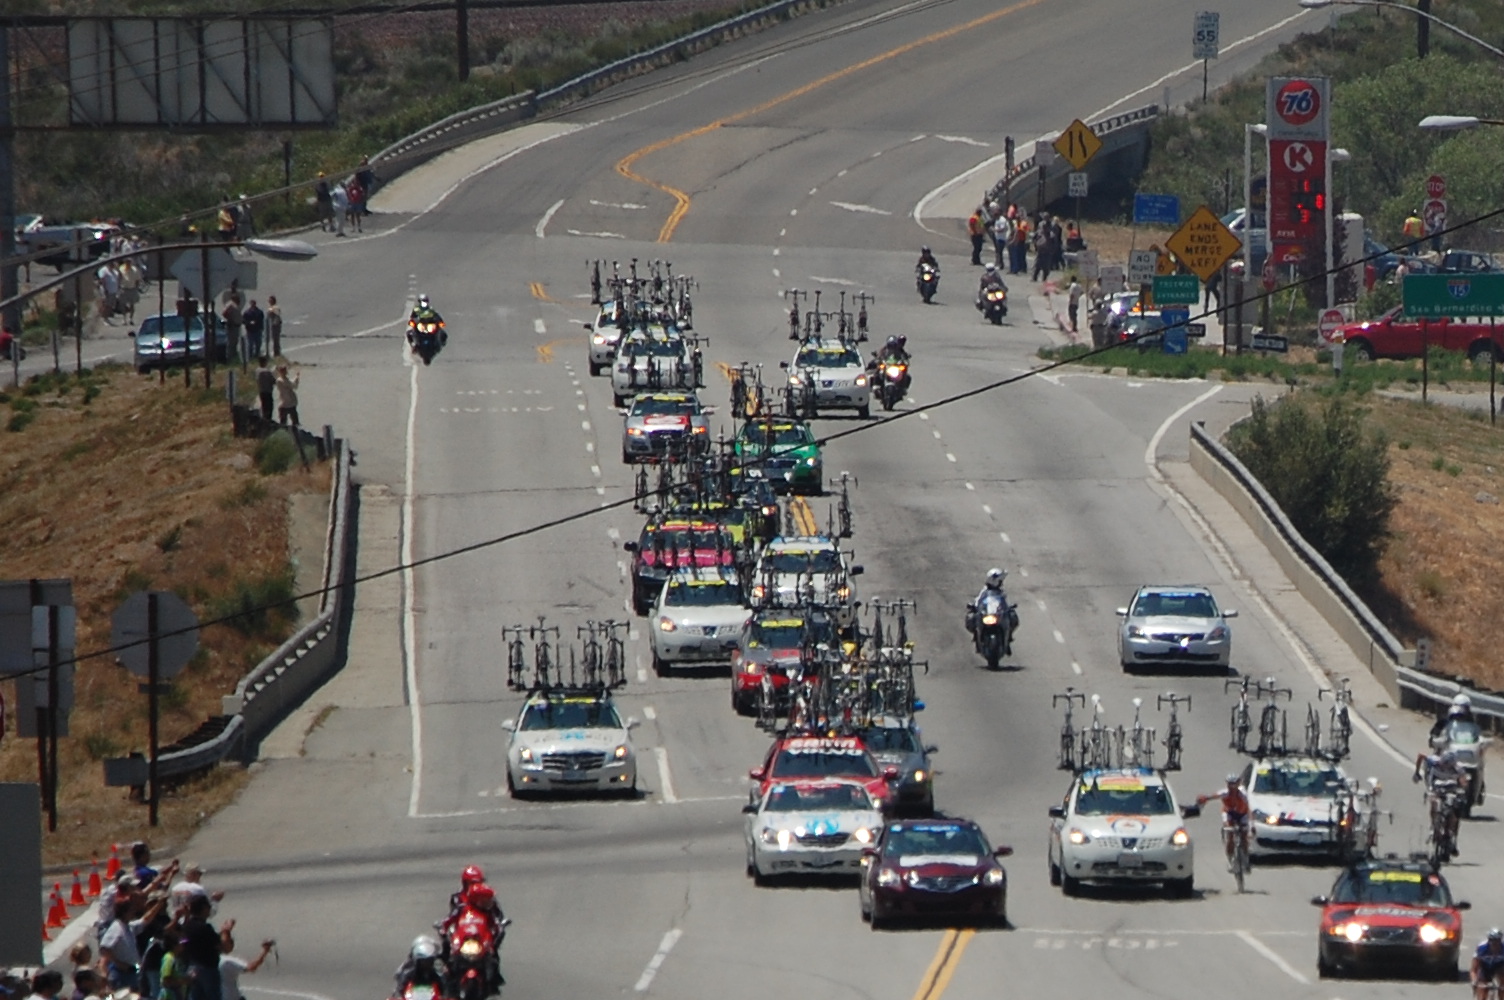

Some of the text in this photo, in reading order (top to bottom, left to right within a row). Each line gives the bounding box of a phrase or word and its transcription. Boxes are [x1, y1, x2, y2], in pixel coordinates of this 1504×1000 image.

[1281, 89, 1313, 115] 76
[1287, 145, 1311, 170] K
[1190, 223, 1217, 231] LANE
[1190, 234, 1219, 244] ENDS
[1185, 245, 1222, 255] MERGE
[1190, 258, 1217, 267] LEFT
[1454, 286, 1466, 296] 15
[1410, 303, 1493, 313] San Bernardino
